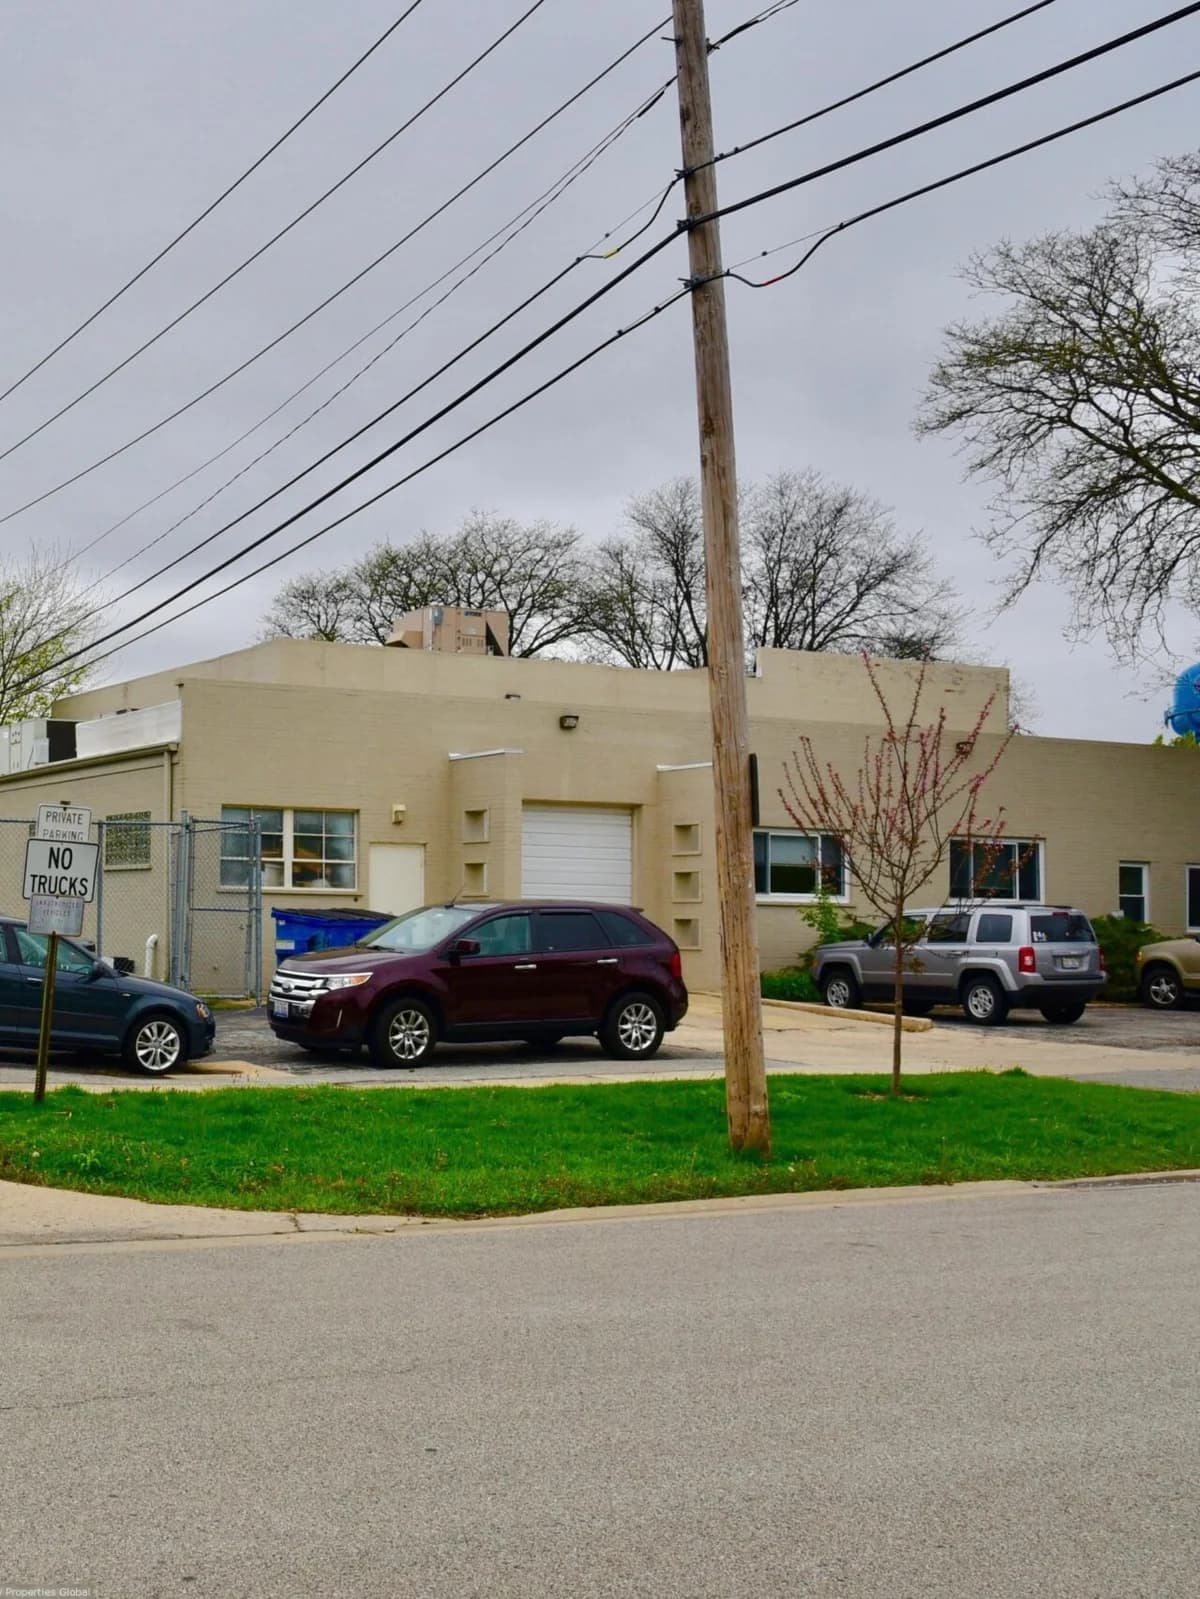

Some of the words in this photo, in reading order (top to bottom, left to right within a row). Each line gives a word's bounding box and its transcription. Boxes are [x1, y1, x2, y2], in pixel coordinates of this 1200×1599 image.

[46, 810, 83, 825] PRIVATE
[42, 829, 84, 841] PARKING
[48, 846, 73, 870] NO
[30, 874, 88, 897] TRUCKS
